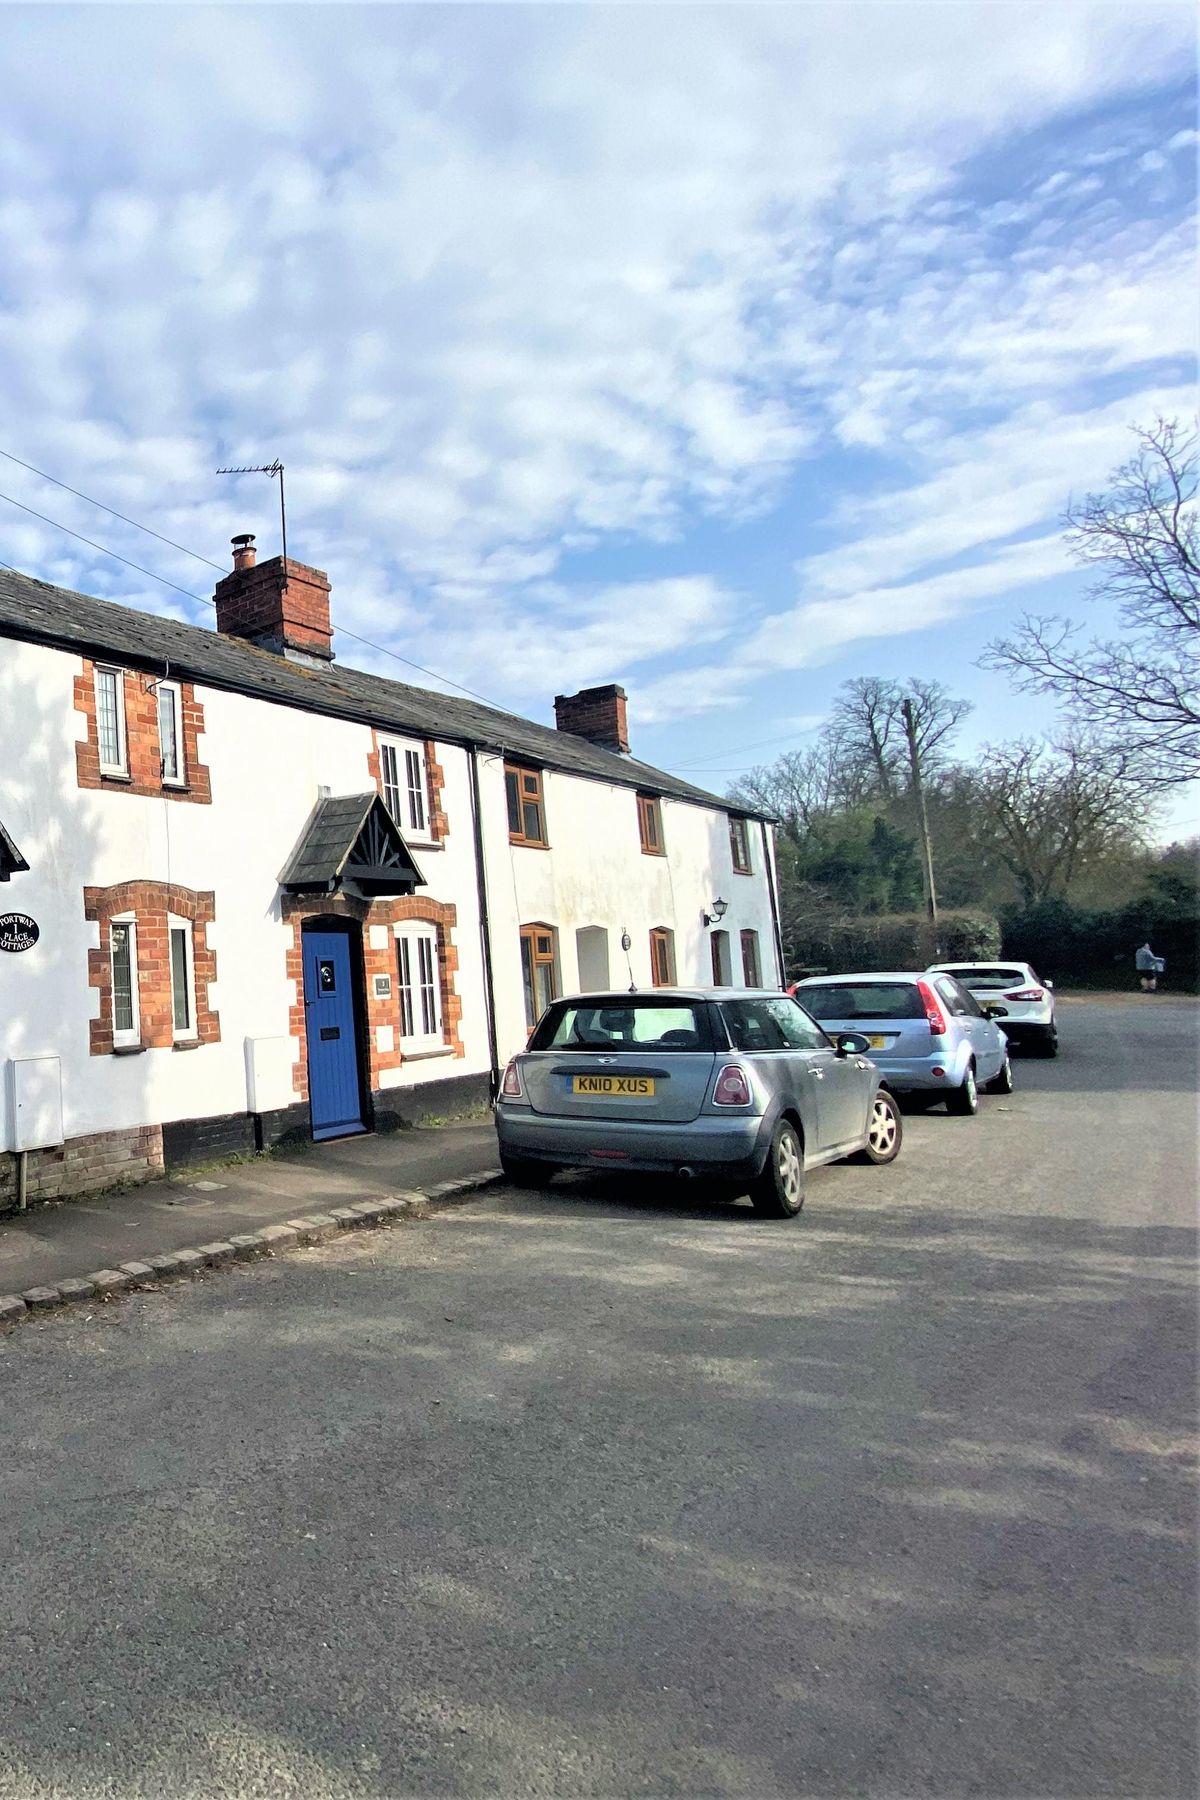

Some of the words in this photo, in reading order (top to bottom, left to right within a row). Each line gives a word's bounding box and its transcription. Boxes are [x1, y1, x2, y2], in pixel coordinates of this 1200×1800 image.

[0, 915, 34, 928] PORTWAY
[13, 923, 18, 934] 1
[4, 932, 28, 942] PLACE
[578, 1078, 612, 1091] KN10
[617, 1079, 648, 1092] XUS
